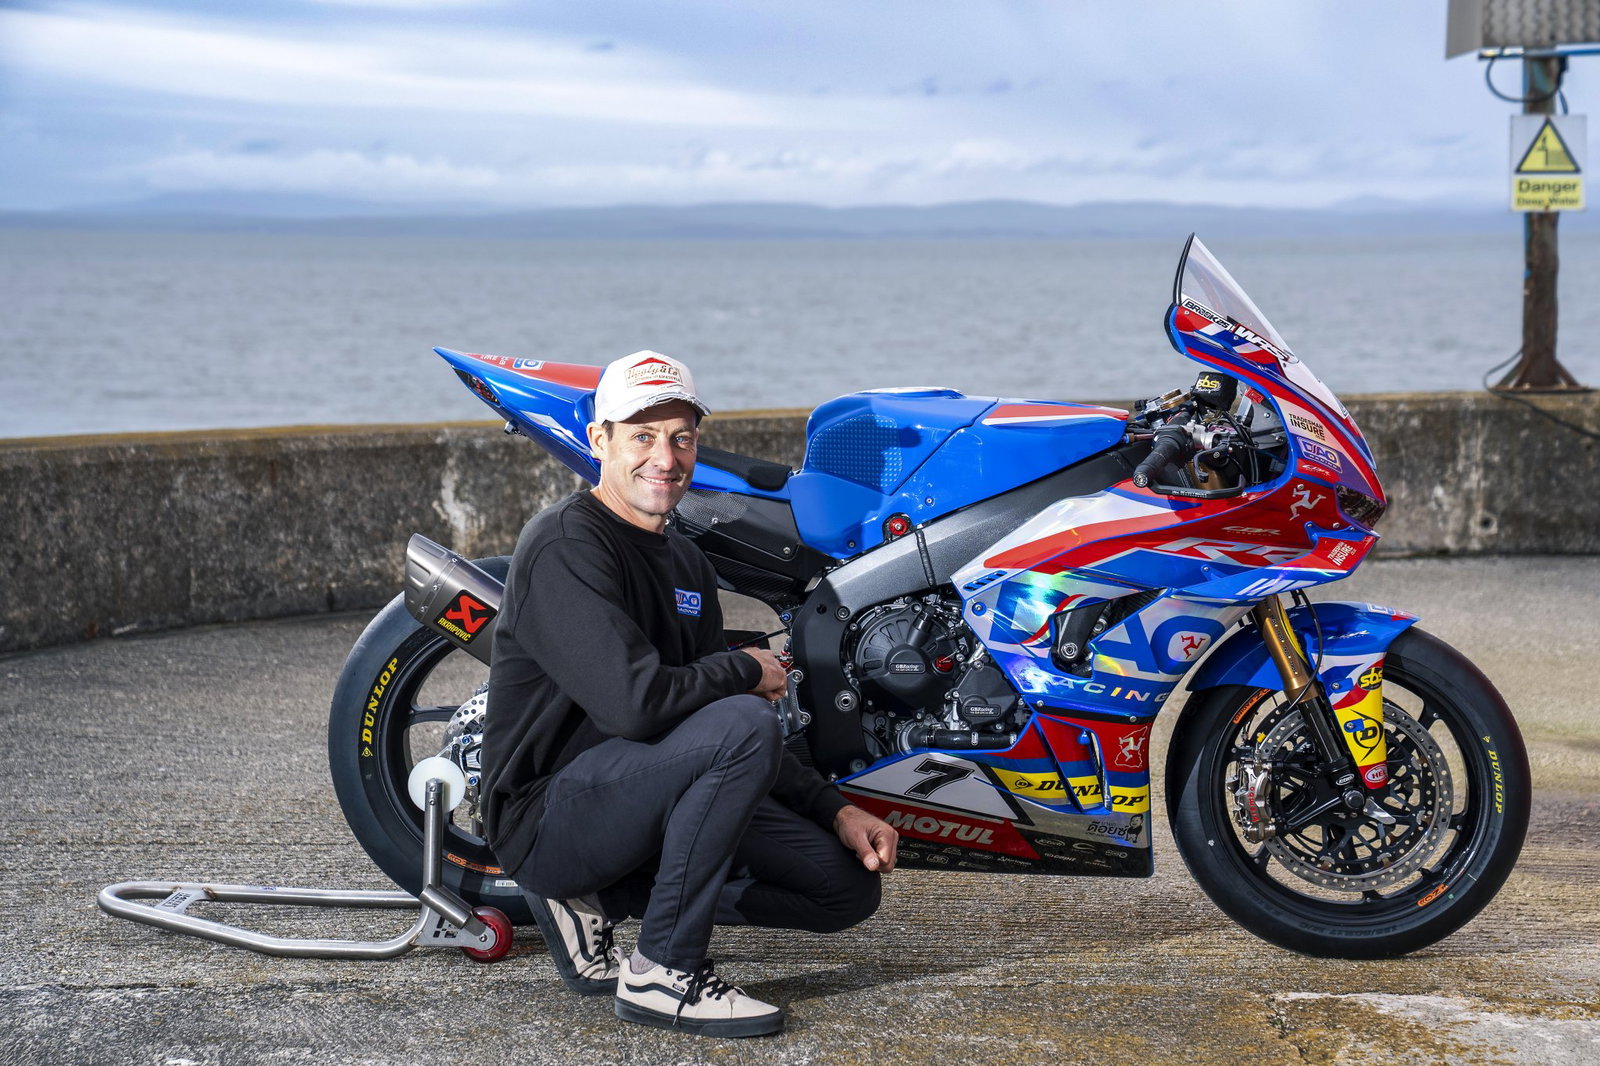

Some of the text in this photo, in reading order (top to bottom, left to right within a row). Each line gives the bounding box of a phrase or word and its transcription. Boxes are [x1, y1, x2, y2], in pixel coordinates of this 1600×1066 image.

[1518, 180, 1577, 195] Danger
[1290, 418, 1326, 438] INSURE
[1332, 543, 1354, 566] INSURE
[437, 617, 471, 642] AKRAPOVIC
[362, 657, 398, 745] DUNLOP
[904, 758, 975, 799] 7
[1488, 750, 1504, 813] DUNLOP
[1035, 780, 1146, 806] DUNLOP
[884, 810, 994, 845] MOTUL
